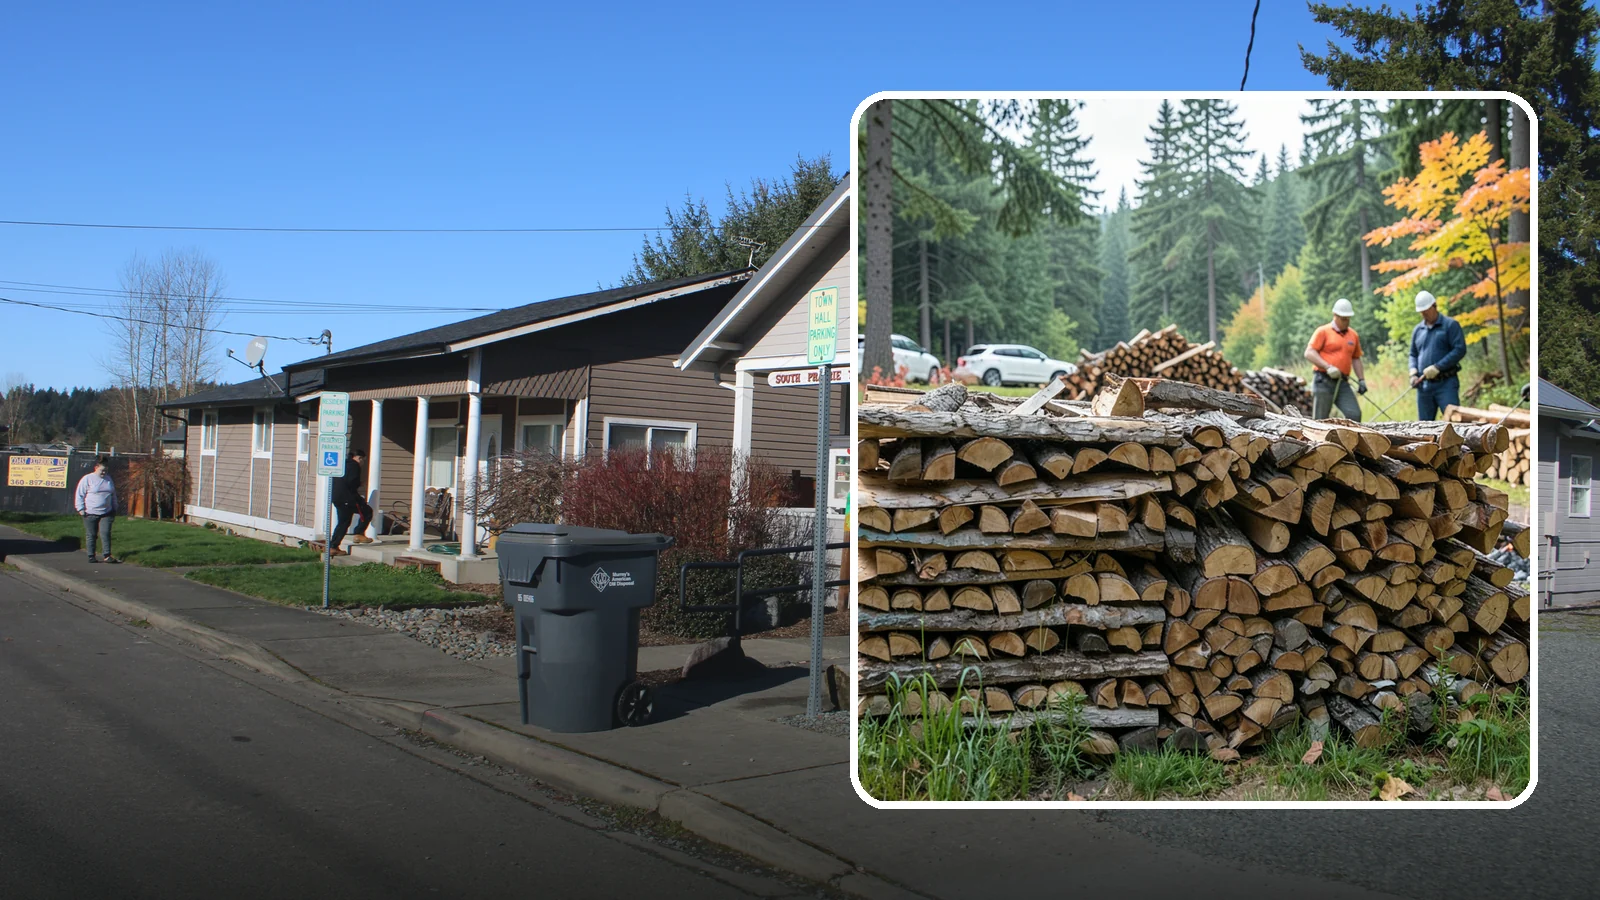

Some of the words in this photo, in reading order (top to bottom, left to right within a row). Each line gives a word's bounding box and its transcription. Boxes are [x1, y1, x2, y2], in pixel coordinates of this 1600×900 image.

[815, 295, 833, 307] TOWN
[815, 312, 831, 324] HALL
[810, 326, 836, 341] PARKING
[813, 344, 831, 357] ONLY
[775, 373, 801, 384] SOUTH
